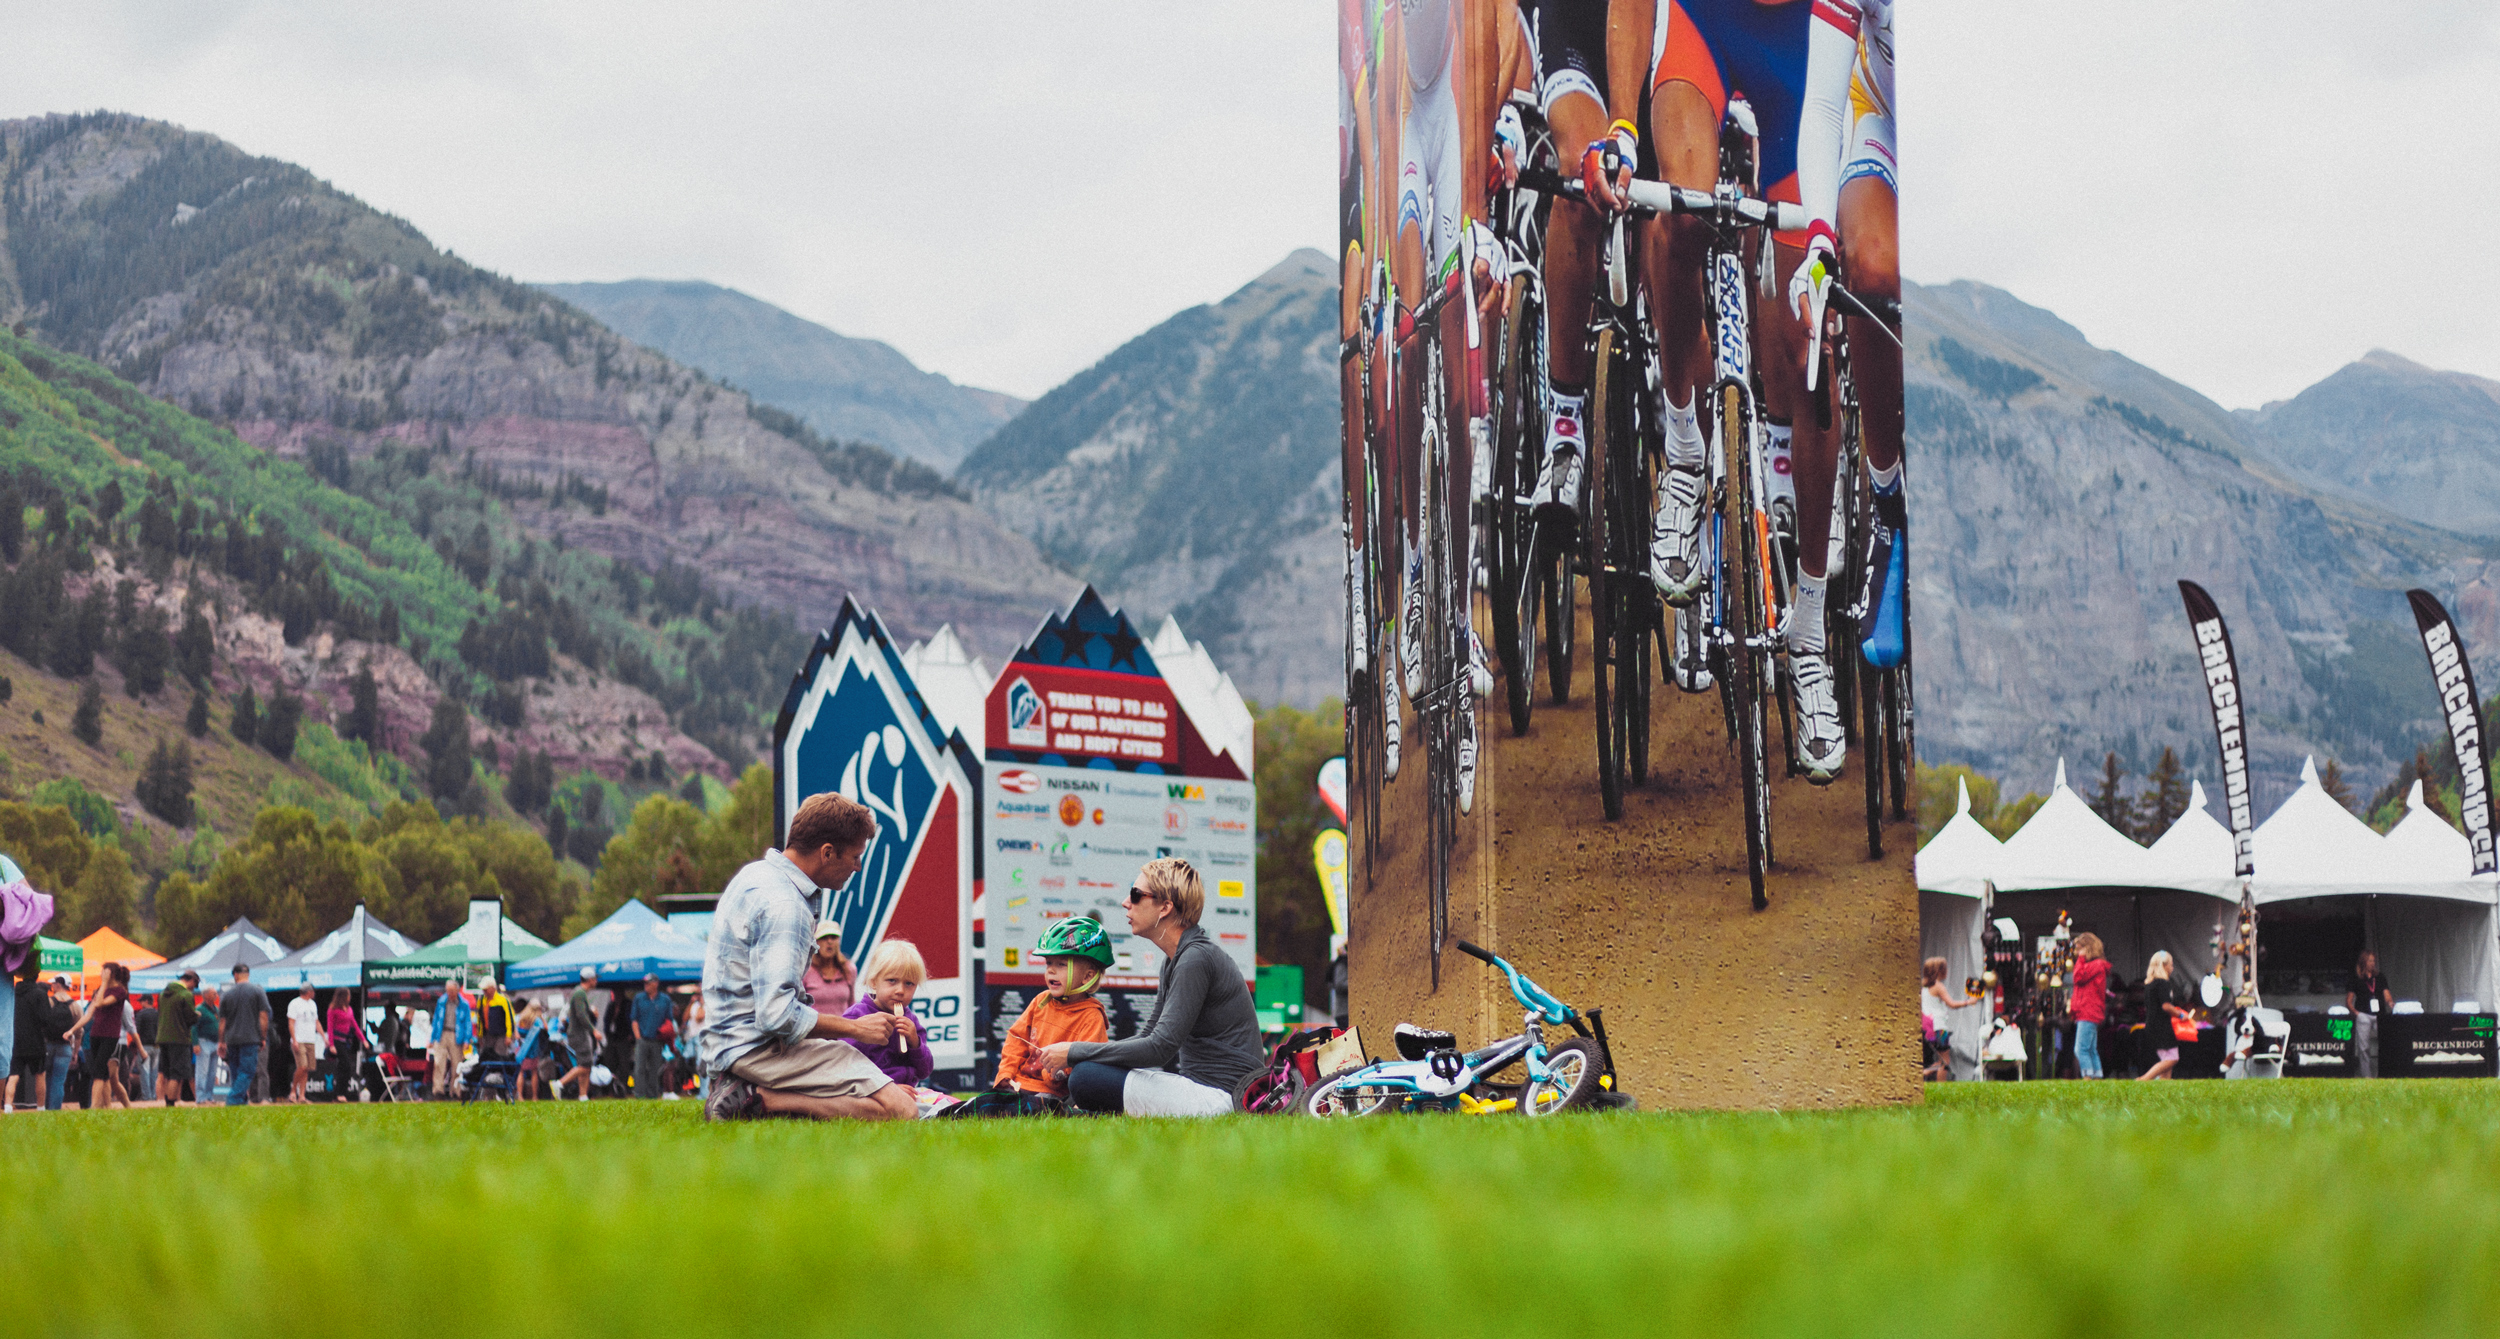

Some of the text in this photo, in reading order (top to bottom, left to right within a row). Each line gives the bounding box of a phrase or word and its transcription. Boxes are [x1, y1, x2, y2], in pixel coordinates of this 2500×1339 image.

[1047, 690, 1168, 719] THANK YOU TO ALL
[1051, 711, 1166, 739] OF OUR PARTNERS
[1055, 732, 1164, 758] AND HOST CITIES
[2195, 617, 2253, 872] BRECKENRIDGE
[2425, 620, 2495, 872] BRECKENRIDGE
[1047, 778, 1100, 791] NISSAN
[1167, 783, 1205, 800] WM
[909, 995, 960, 1018] RO
[926, 1024, 960, 1042] GE
[2412, 1040, 2485, 1050] BRECKENRIDGE
[959, 1074, 975, 1092] TM
